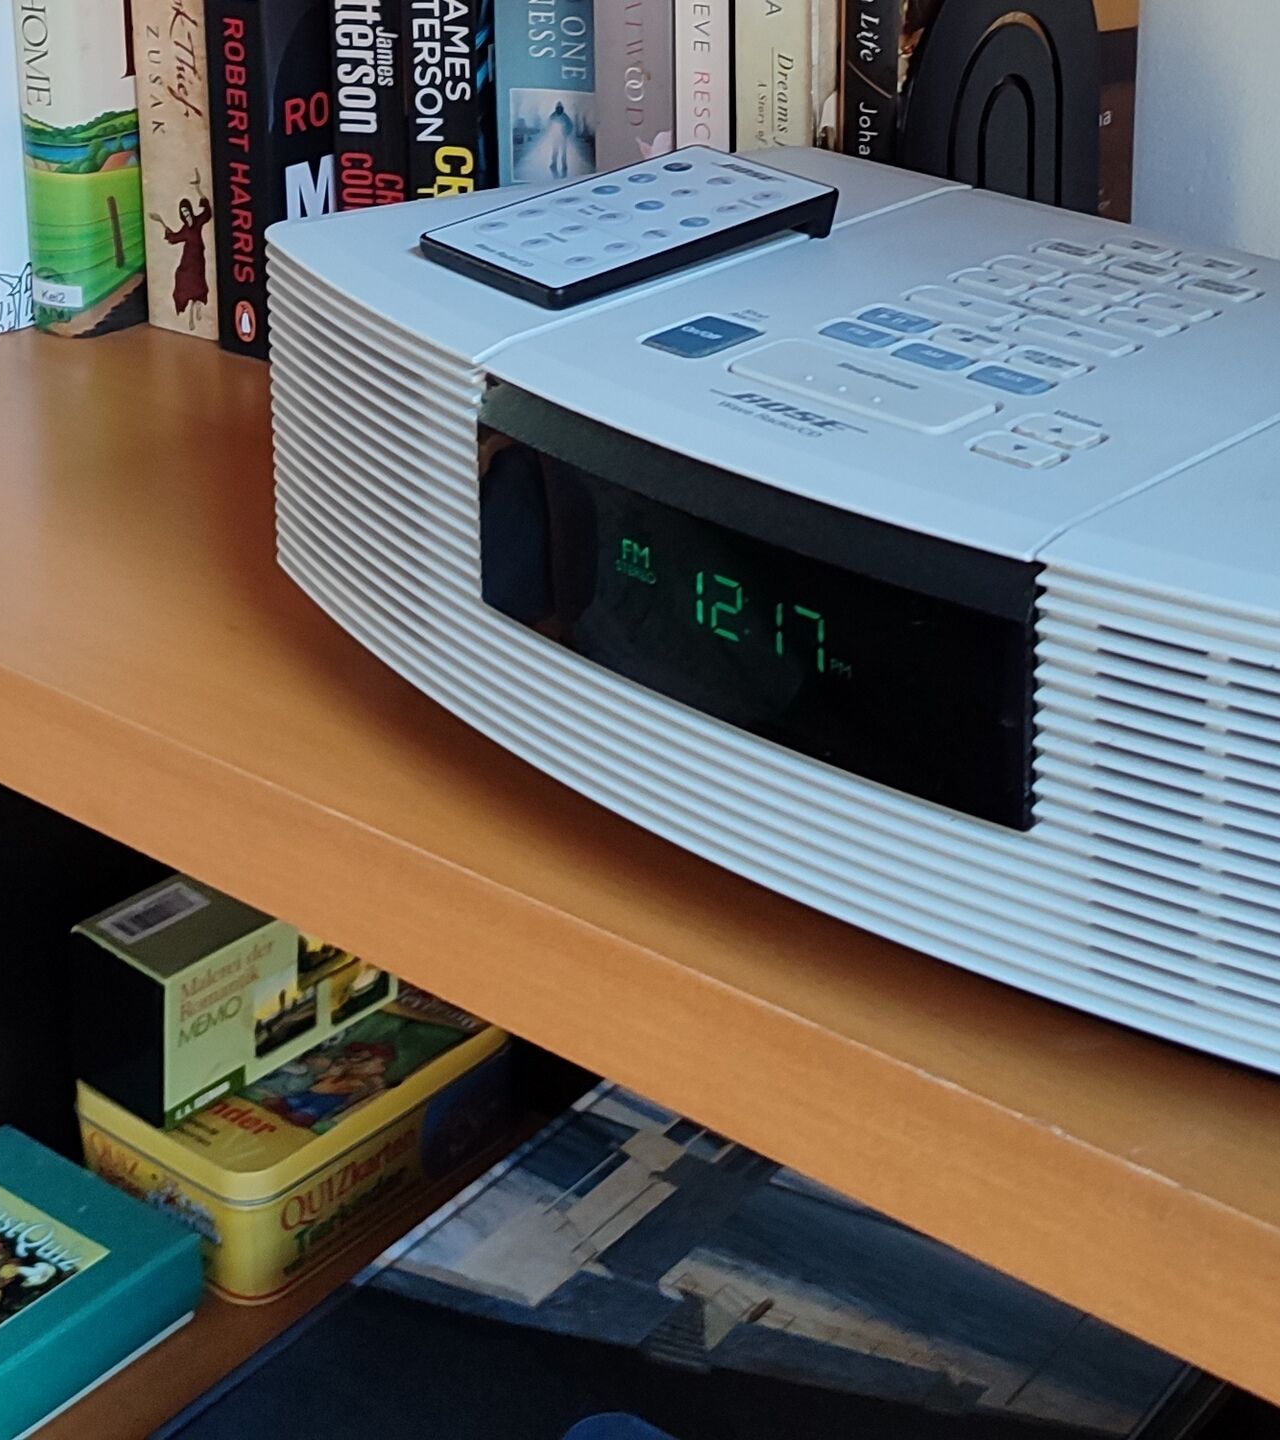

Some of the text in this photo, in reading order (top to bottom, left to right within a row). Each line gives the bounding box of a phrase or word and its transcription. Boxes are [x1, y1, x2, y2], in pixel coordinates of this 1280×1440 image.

[376, 25, 400, 88] James
[561, 16, 587, 81] ONE
[624, 1, 645, 128] ATWOOD
[858, 12, 883, 63] Life
[146, 24, 166, 135] ZUSAK
[167, 32, 203, 119] Thief
[222, 16, 251, 153] ROBERT
[693, 70, 711, 147] RESC
[777, 52, 794, 134] Dreams
[858, 101, 879, 157] Joha
[228, 161, 256, 284] HARRIS
[710, 388, 869, 435] BOSE
[621, 538, 650, 570] FM
[177, 994, 243, 1048] MEMO
